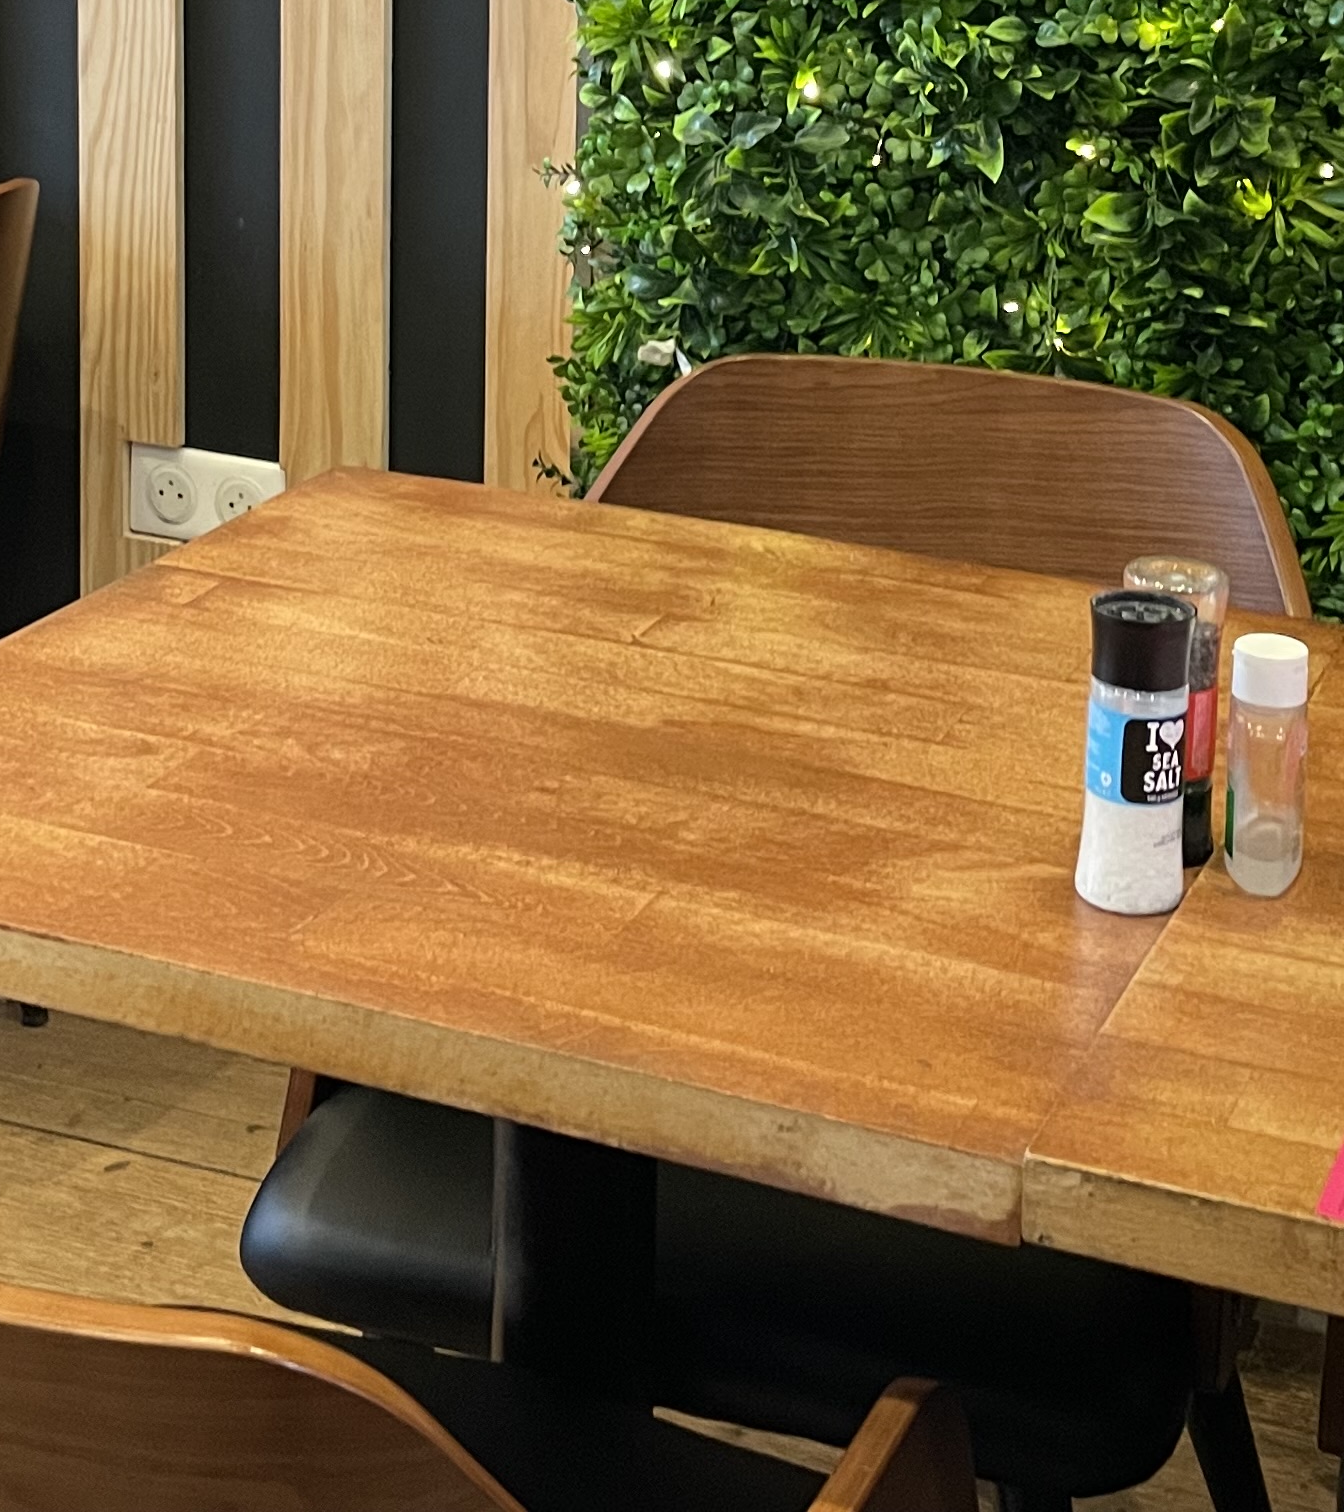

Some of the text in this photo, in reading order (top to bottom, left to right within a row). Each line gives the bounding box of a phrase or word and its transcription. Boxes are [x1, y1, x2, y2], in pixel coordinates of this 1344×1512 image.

[1145, 721, 1160, 753] I
[1152, 749, 1179, 772] SEA
[1143, 765, 1182, 793] SALT
